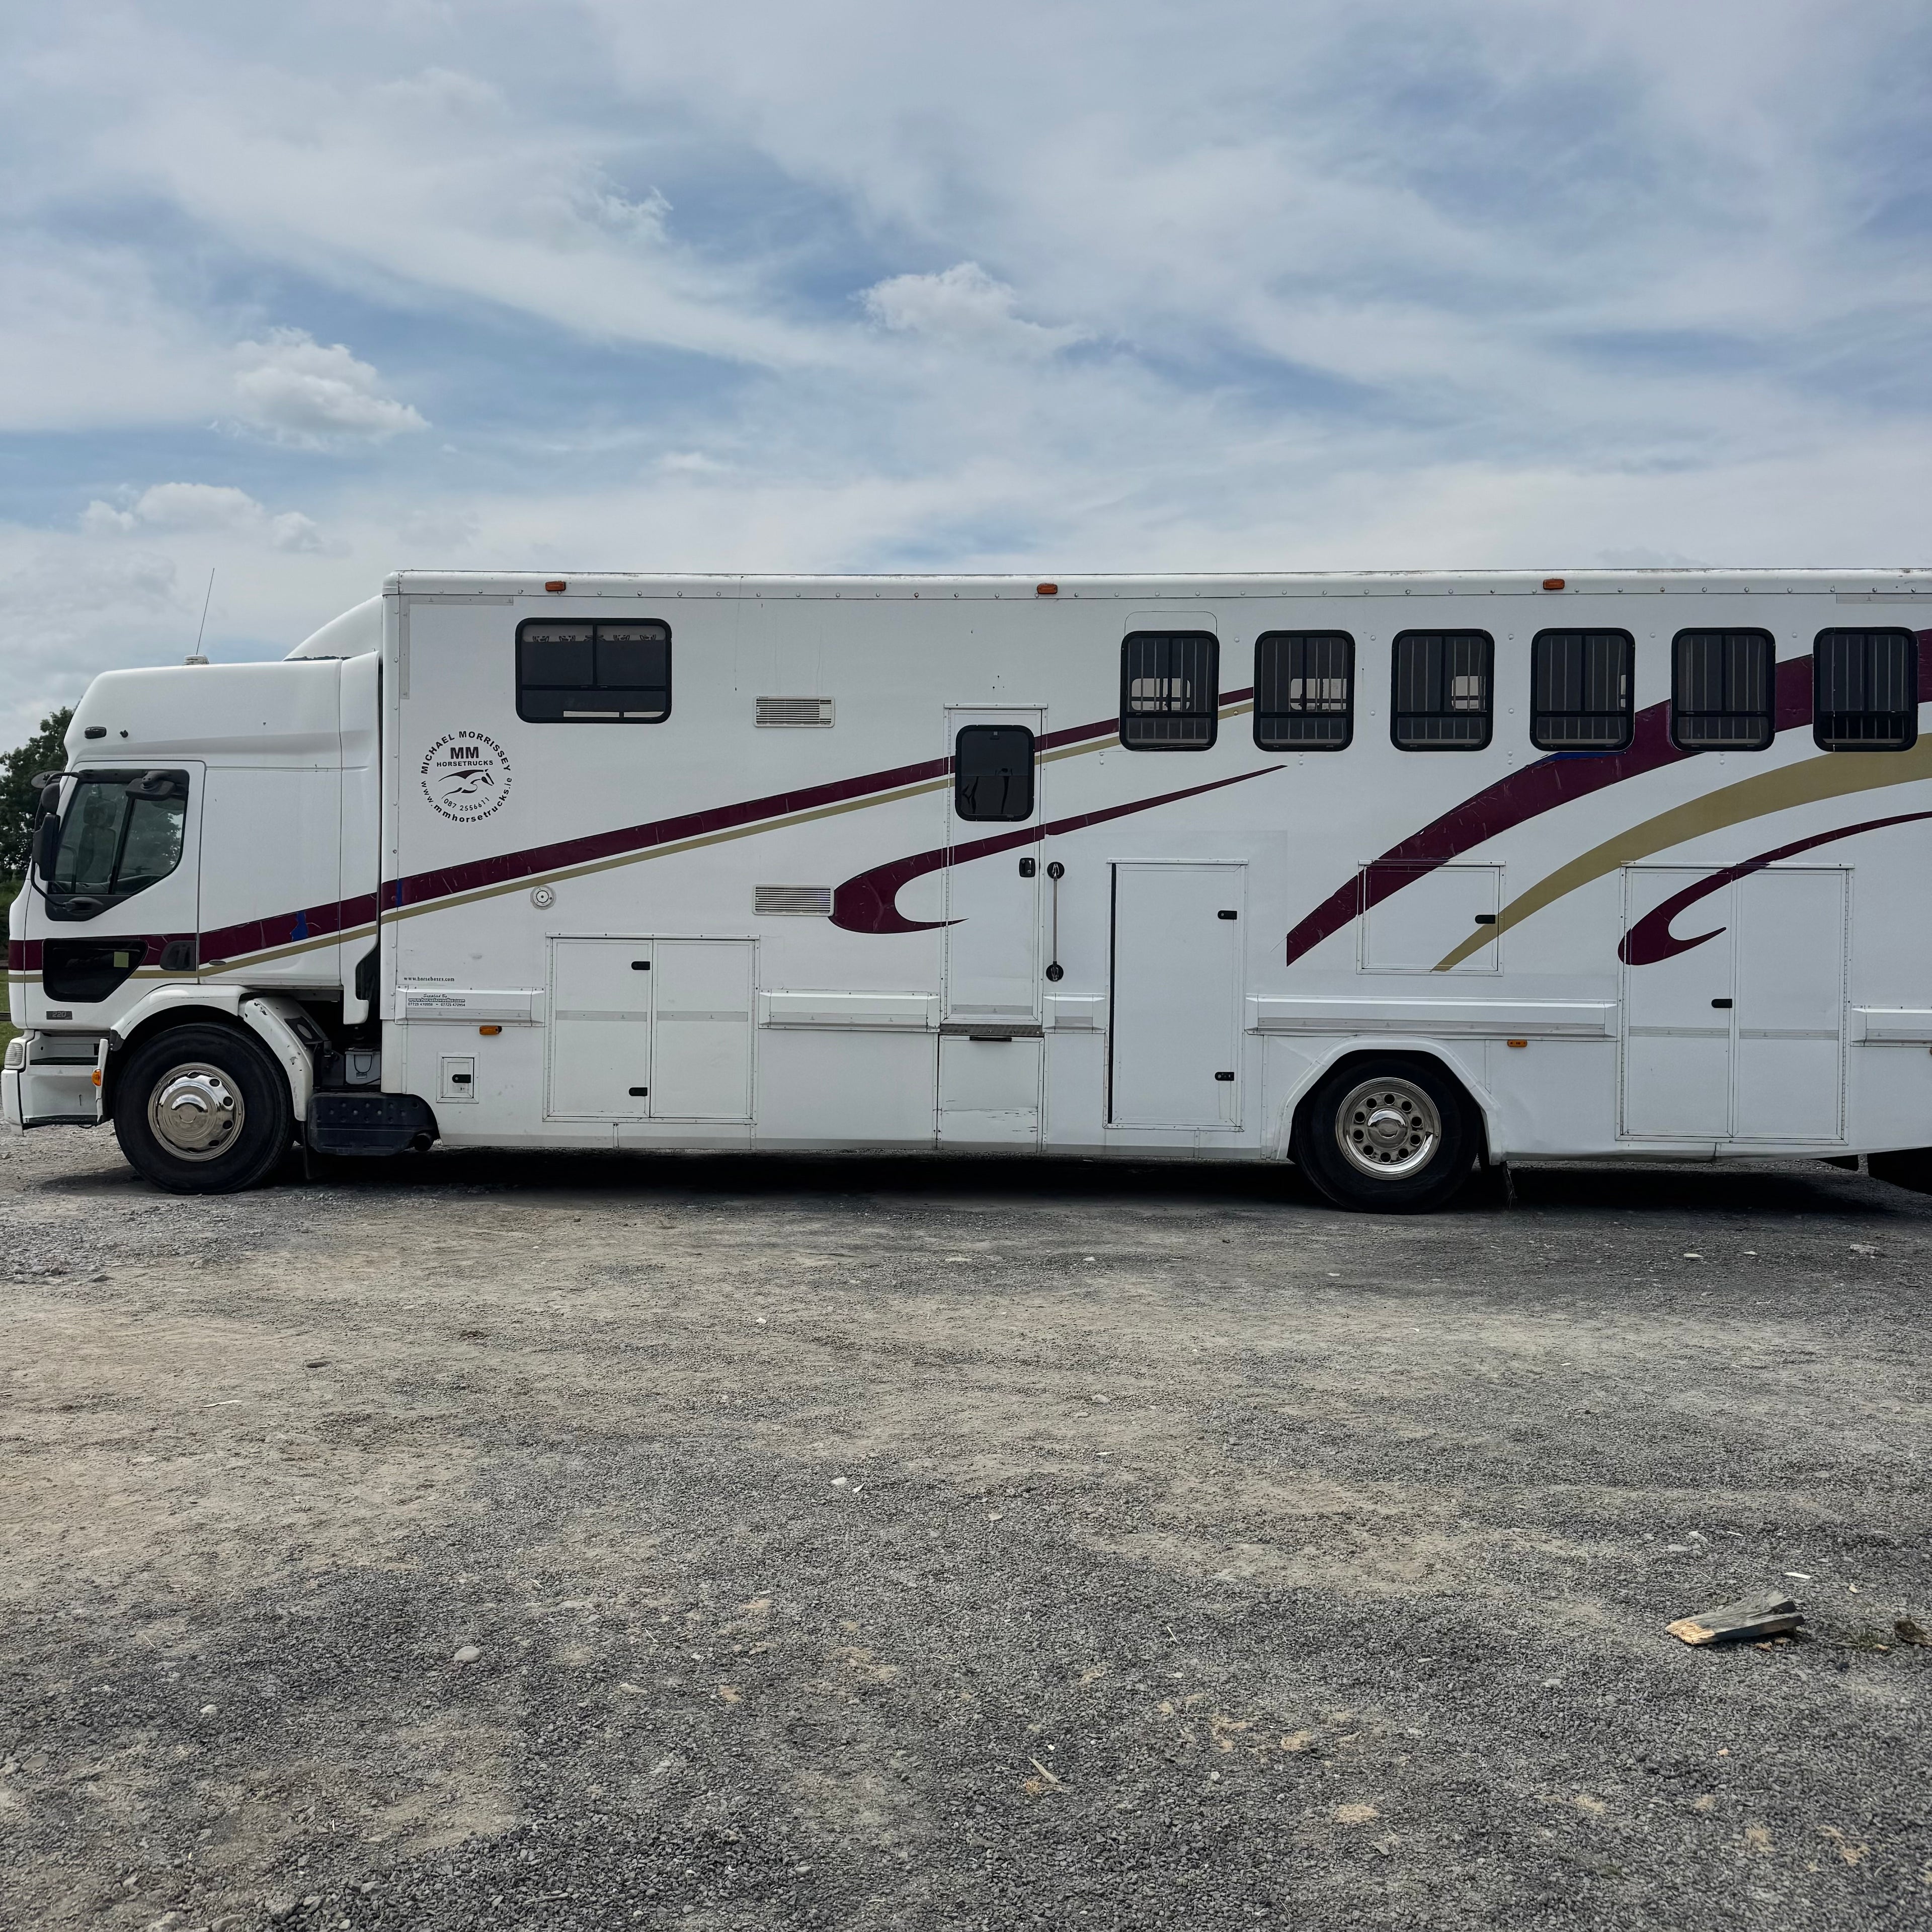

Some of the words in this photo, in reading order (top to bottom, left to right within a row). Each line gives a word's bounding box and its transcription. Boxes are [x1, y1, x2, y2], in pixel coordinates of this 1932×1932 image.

[421, 734, 455, 774] MICHAEL
[459, 731, 511, 771] MORRISSEY
[450, 747, 479, 759] MM
[421, 777, 512, 823] www.mmhorsetrucks.ie
[444, 798, 457, 809] 087
[459, 797, 490, 811] 2556611
